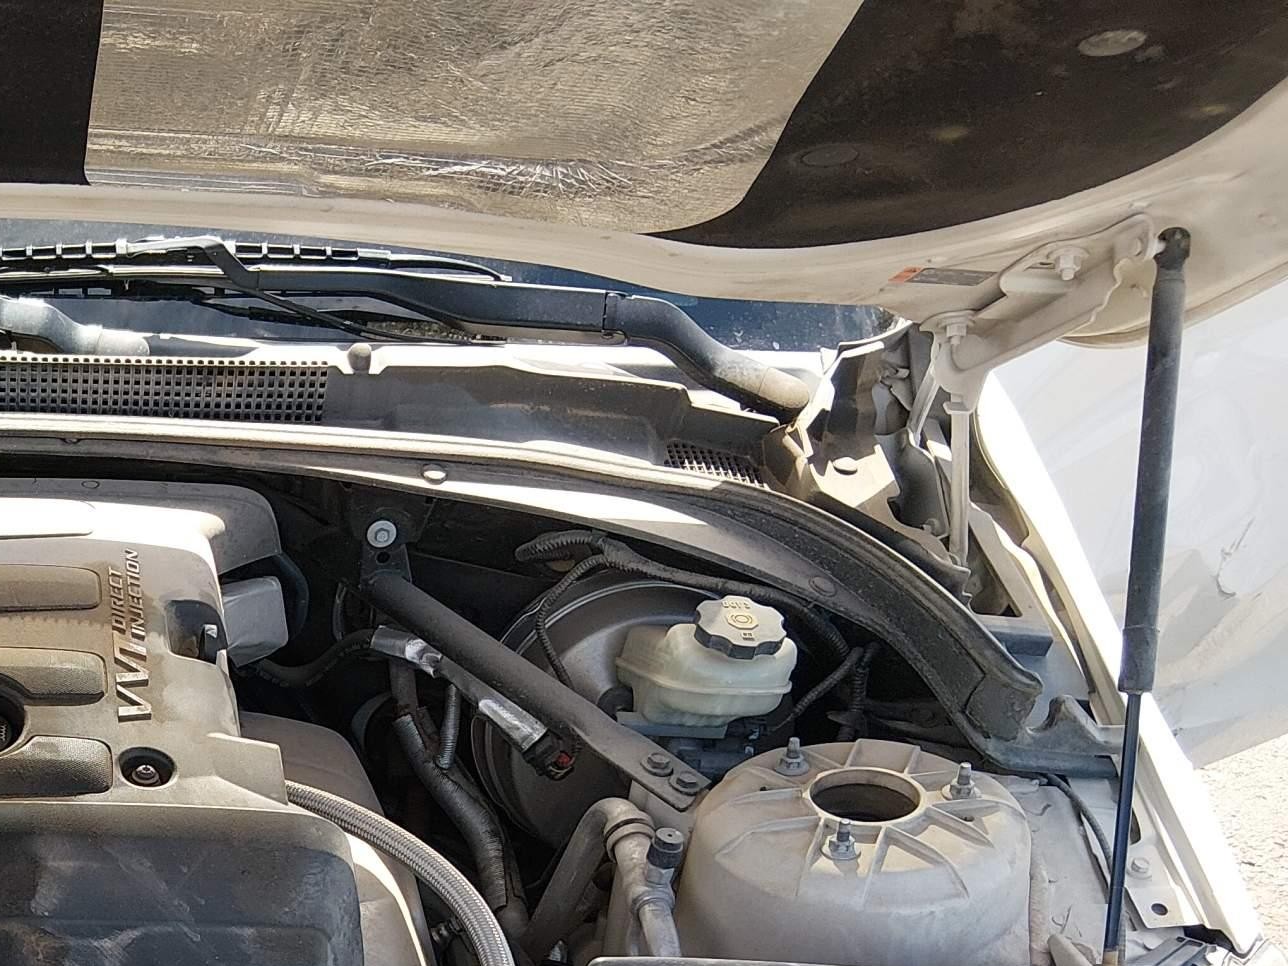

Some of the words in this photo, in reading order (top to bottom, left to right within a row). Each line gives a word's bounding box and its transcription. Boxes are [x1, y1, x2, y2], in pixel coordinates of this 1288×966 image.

[108, 566, 126, 633] DIRECT
[125, 548, 145, 640] INJECTION
[112, 632, 152, 723] VVT
